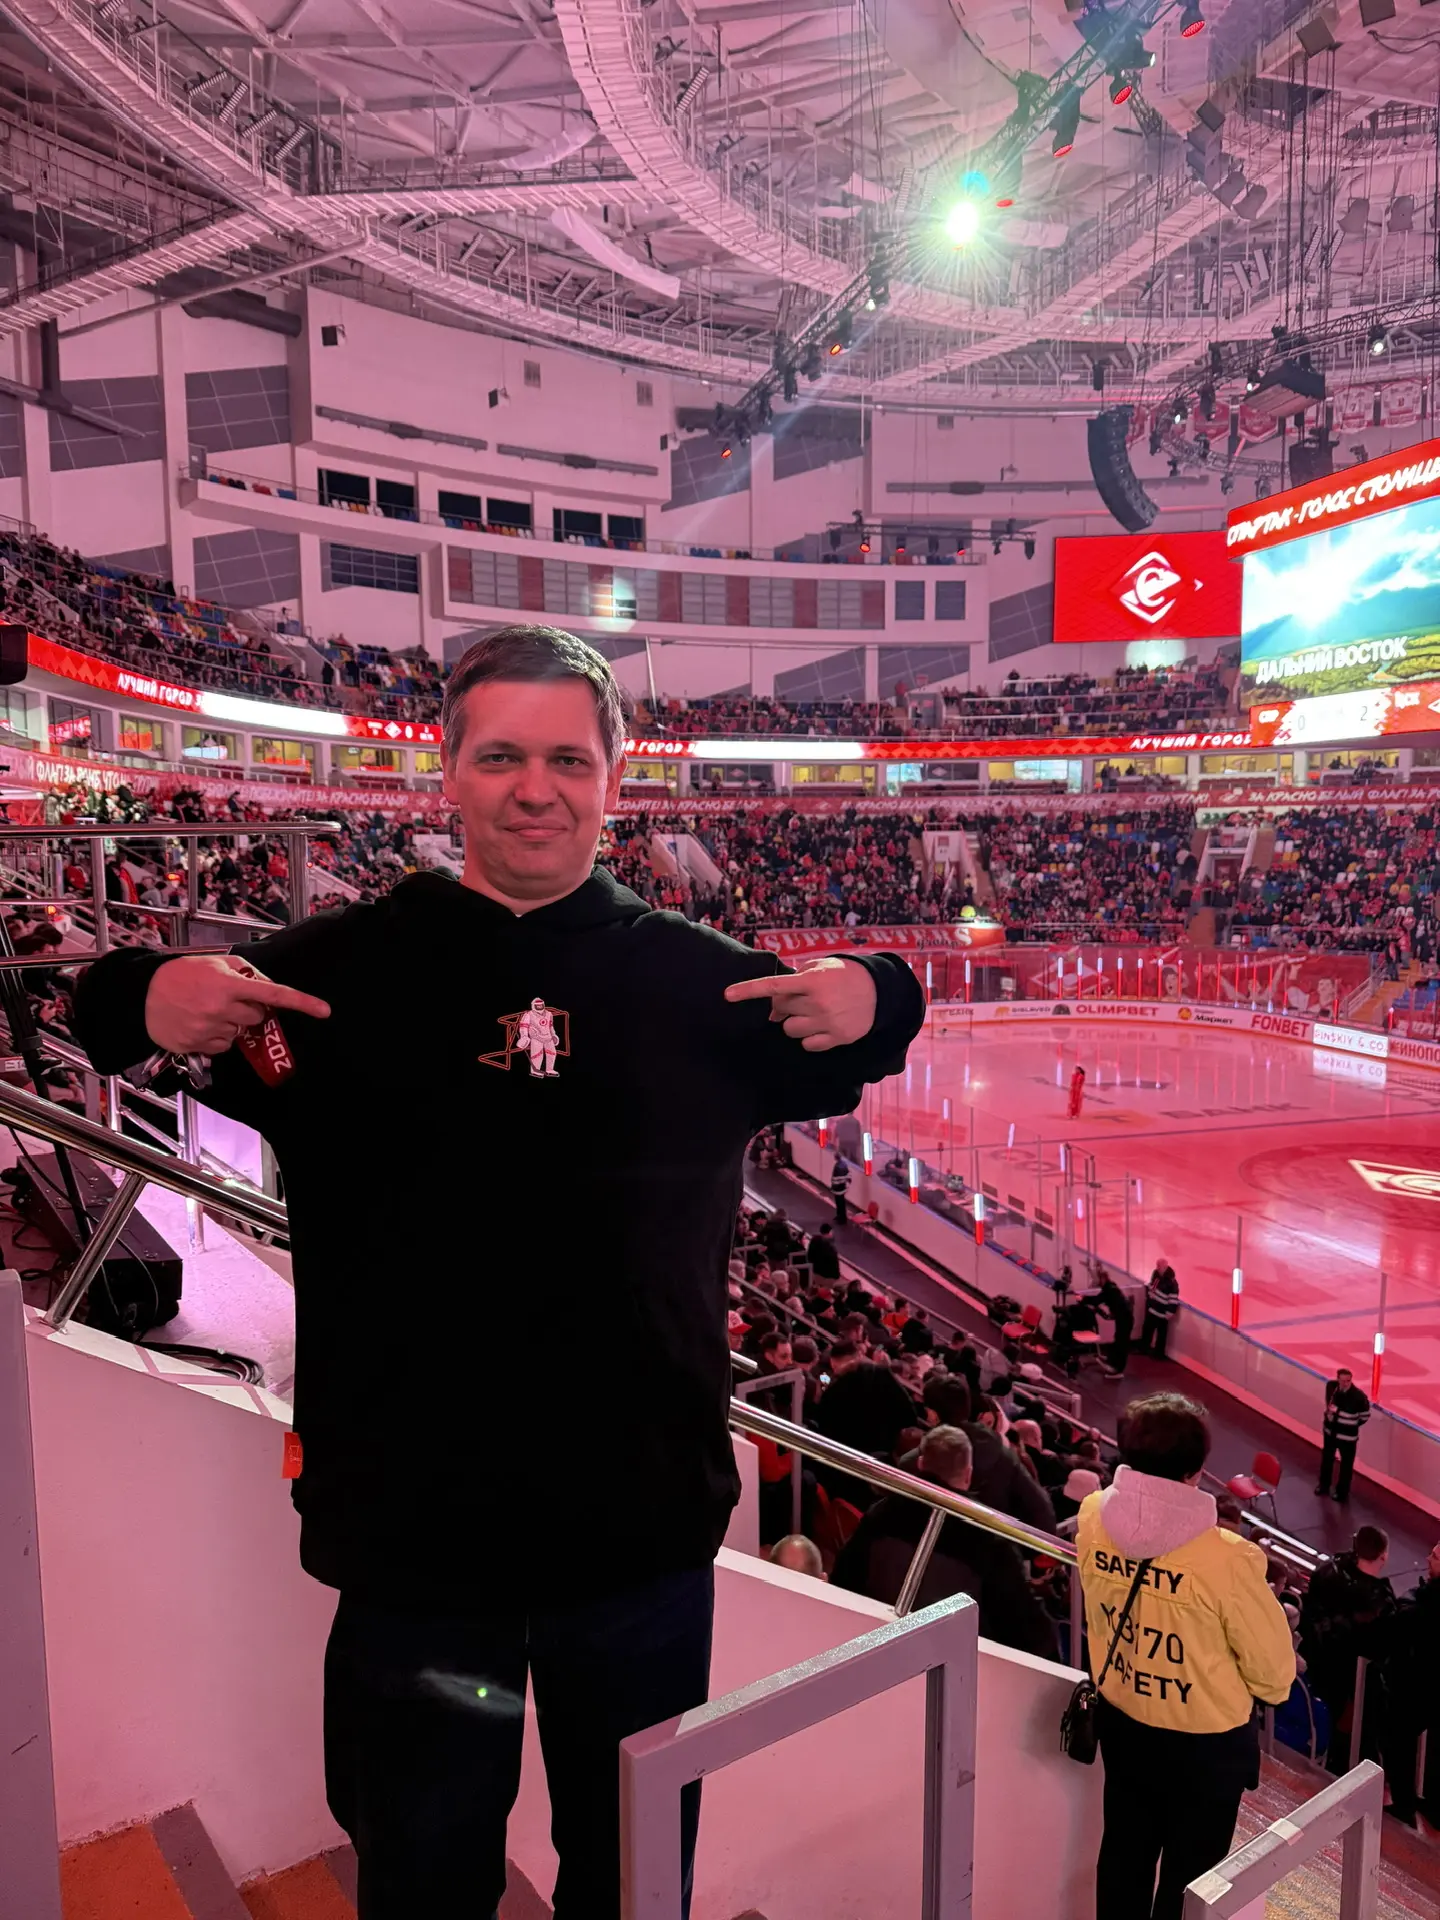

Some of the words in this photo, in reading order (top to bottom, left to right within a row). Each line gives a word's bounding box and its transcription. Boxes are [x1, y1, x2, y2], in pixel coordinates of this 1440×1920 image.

[1298, 486, 1357, 524] ГОЛОС
[1255, 646, 1333, 685] ДАЛЬНИЙ
[1334, 636, 1409, 669] ВОСТОК
[118, 672, 158, 698] ЛУЧШИЙ
[159, 686, 193, 706] ГОРОД
[1360, 706, 1368, 722] 2
[1129, 734, 1197, 750] ЛУЧШИЙ
[764, 927, 972, 952] SUPPRTERS
[1076, 1004, 1159, 1017] OLIMPBET
[1251, 1014, 1310, 1038] FONBET
[264, 1019, 292, 1073] 2025
[1095, 1550, 1184, 1594] SAFETY
[1107, 1648, 1192, 1705] AFETY
